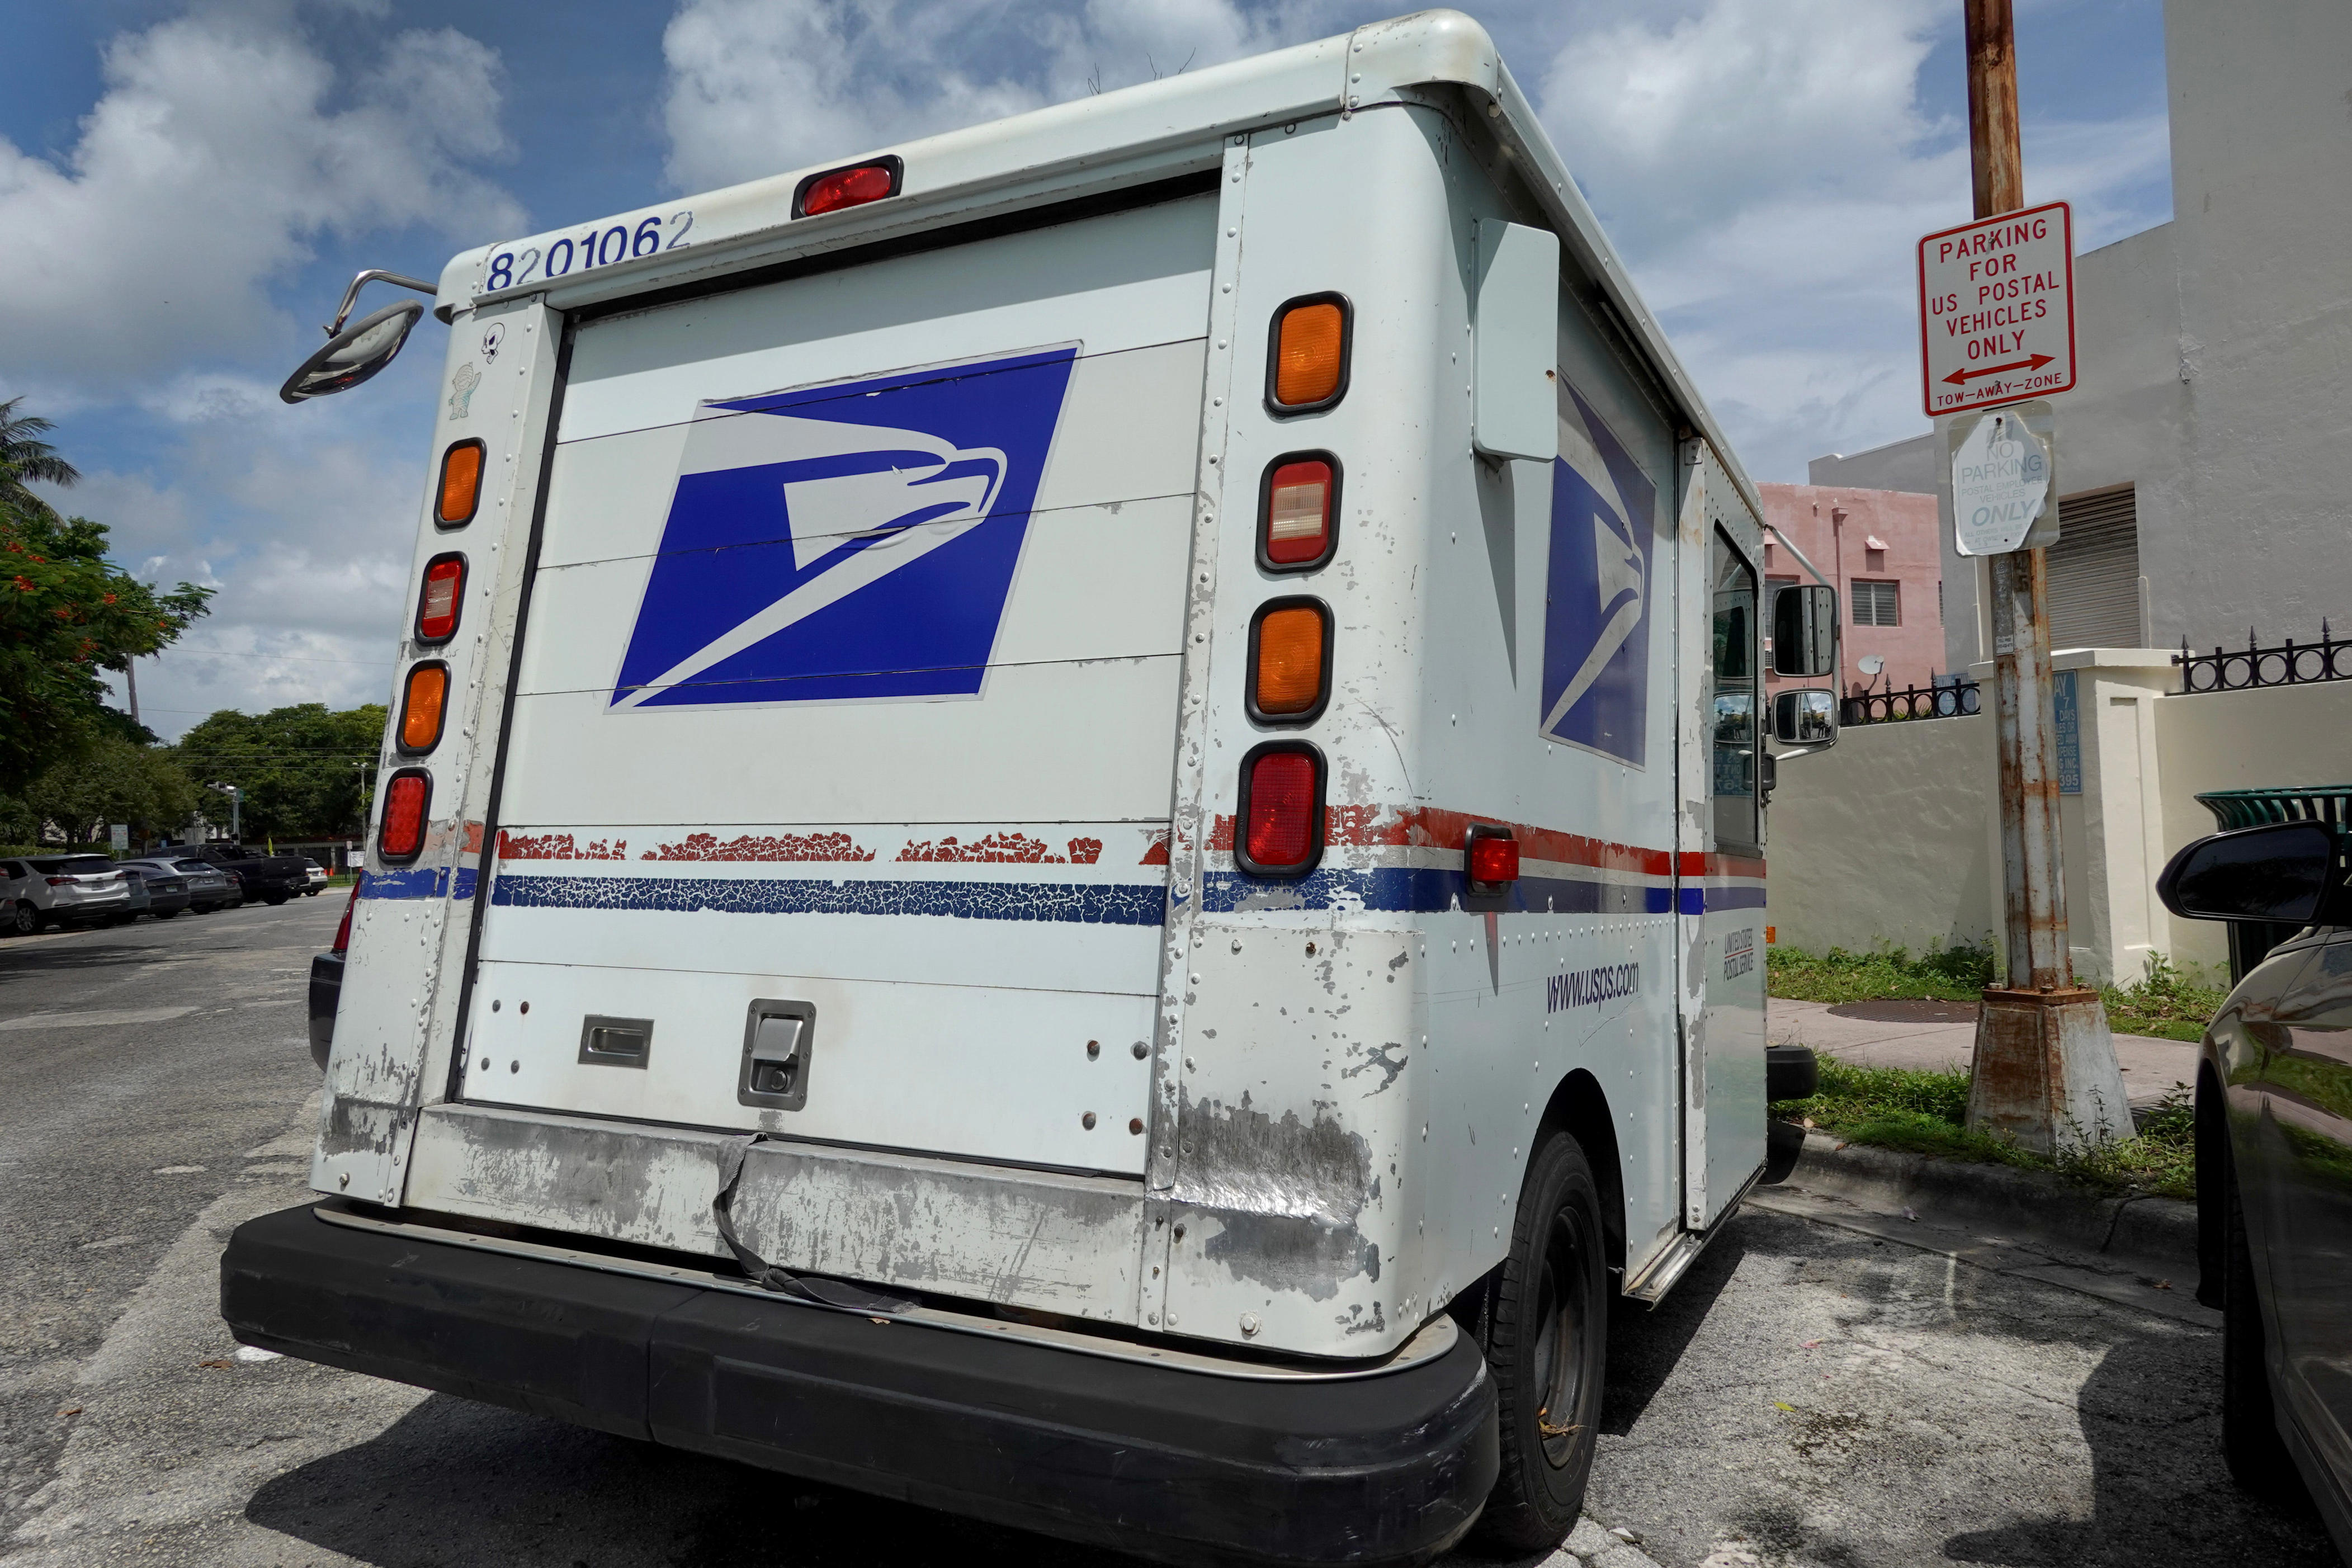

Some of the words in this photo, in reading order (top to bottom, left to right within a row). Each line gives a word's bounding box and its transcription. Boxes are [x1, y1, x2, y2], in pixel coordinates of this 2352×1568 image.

[487, 211, 694, 291] 8201062
[1940, 219, 2047, 263] PARKING
[1970, 254, 2016, 281] FOR
[1932, 294, 1957, 315] US
[1978, 271, 2059, 305] POSTAL
[1947, 299, 2047, 337] VEHICLES
[1968, 329, 2024, 360] ONLY
[1987, 442, 2013, 461] NO
[1962, 455, 2042, 483] PARKING
[1961, 482, 1994, 497] POSTAL
[1996, 475, 2043, 490] EMPLOYEE
[1980, 489, 2026, 503] VEHICLES
[1972, 499, 2036, 527] ONLY
[2060, 709, 2075, 721] DAYS
[2063, 697, 2070, 709] 7
[2067, 722, 2075, 733] OR
[1725, 931, 1740, 955] UNITED
[1740, 928, 1753, 950] STATES
[1723, 957, 1739, 983] POSTAL
[1739, 952, 1753, 975] SERVICE
[1547, 962, 1639, 1014] www.usps.com
